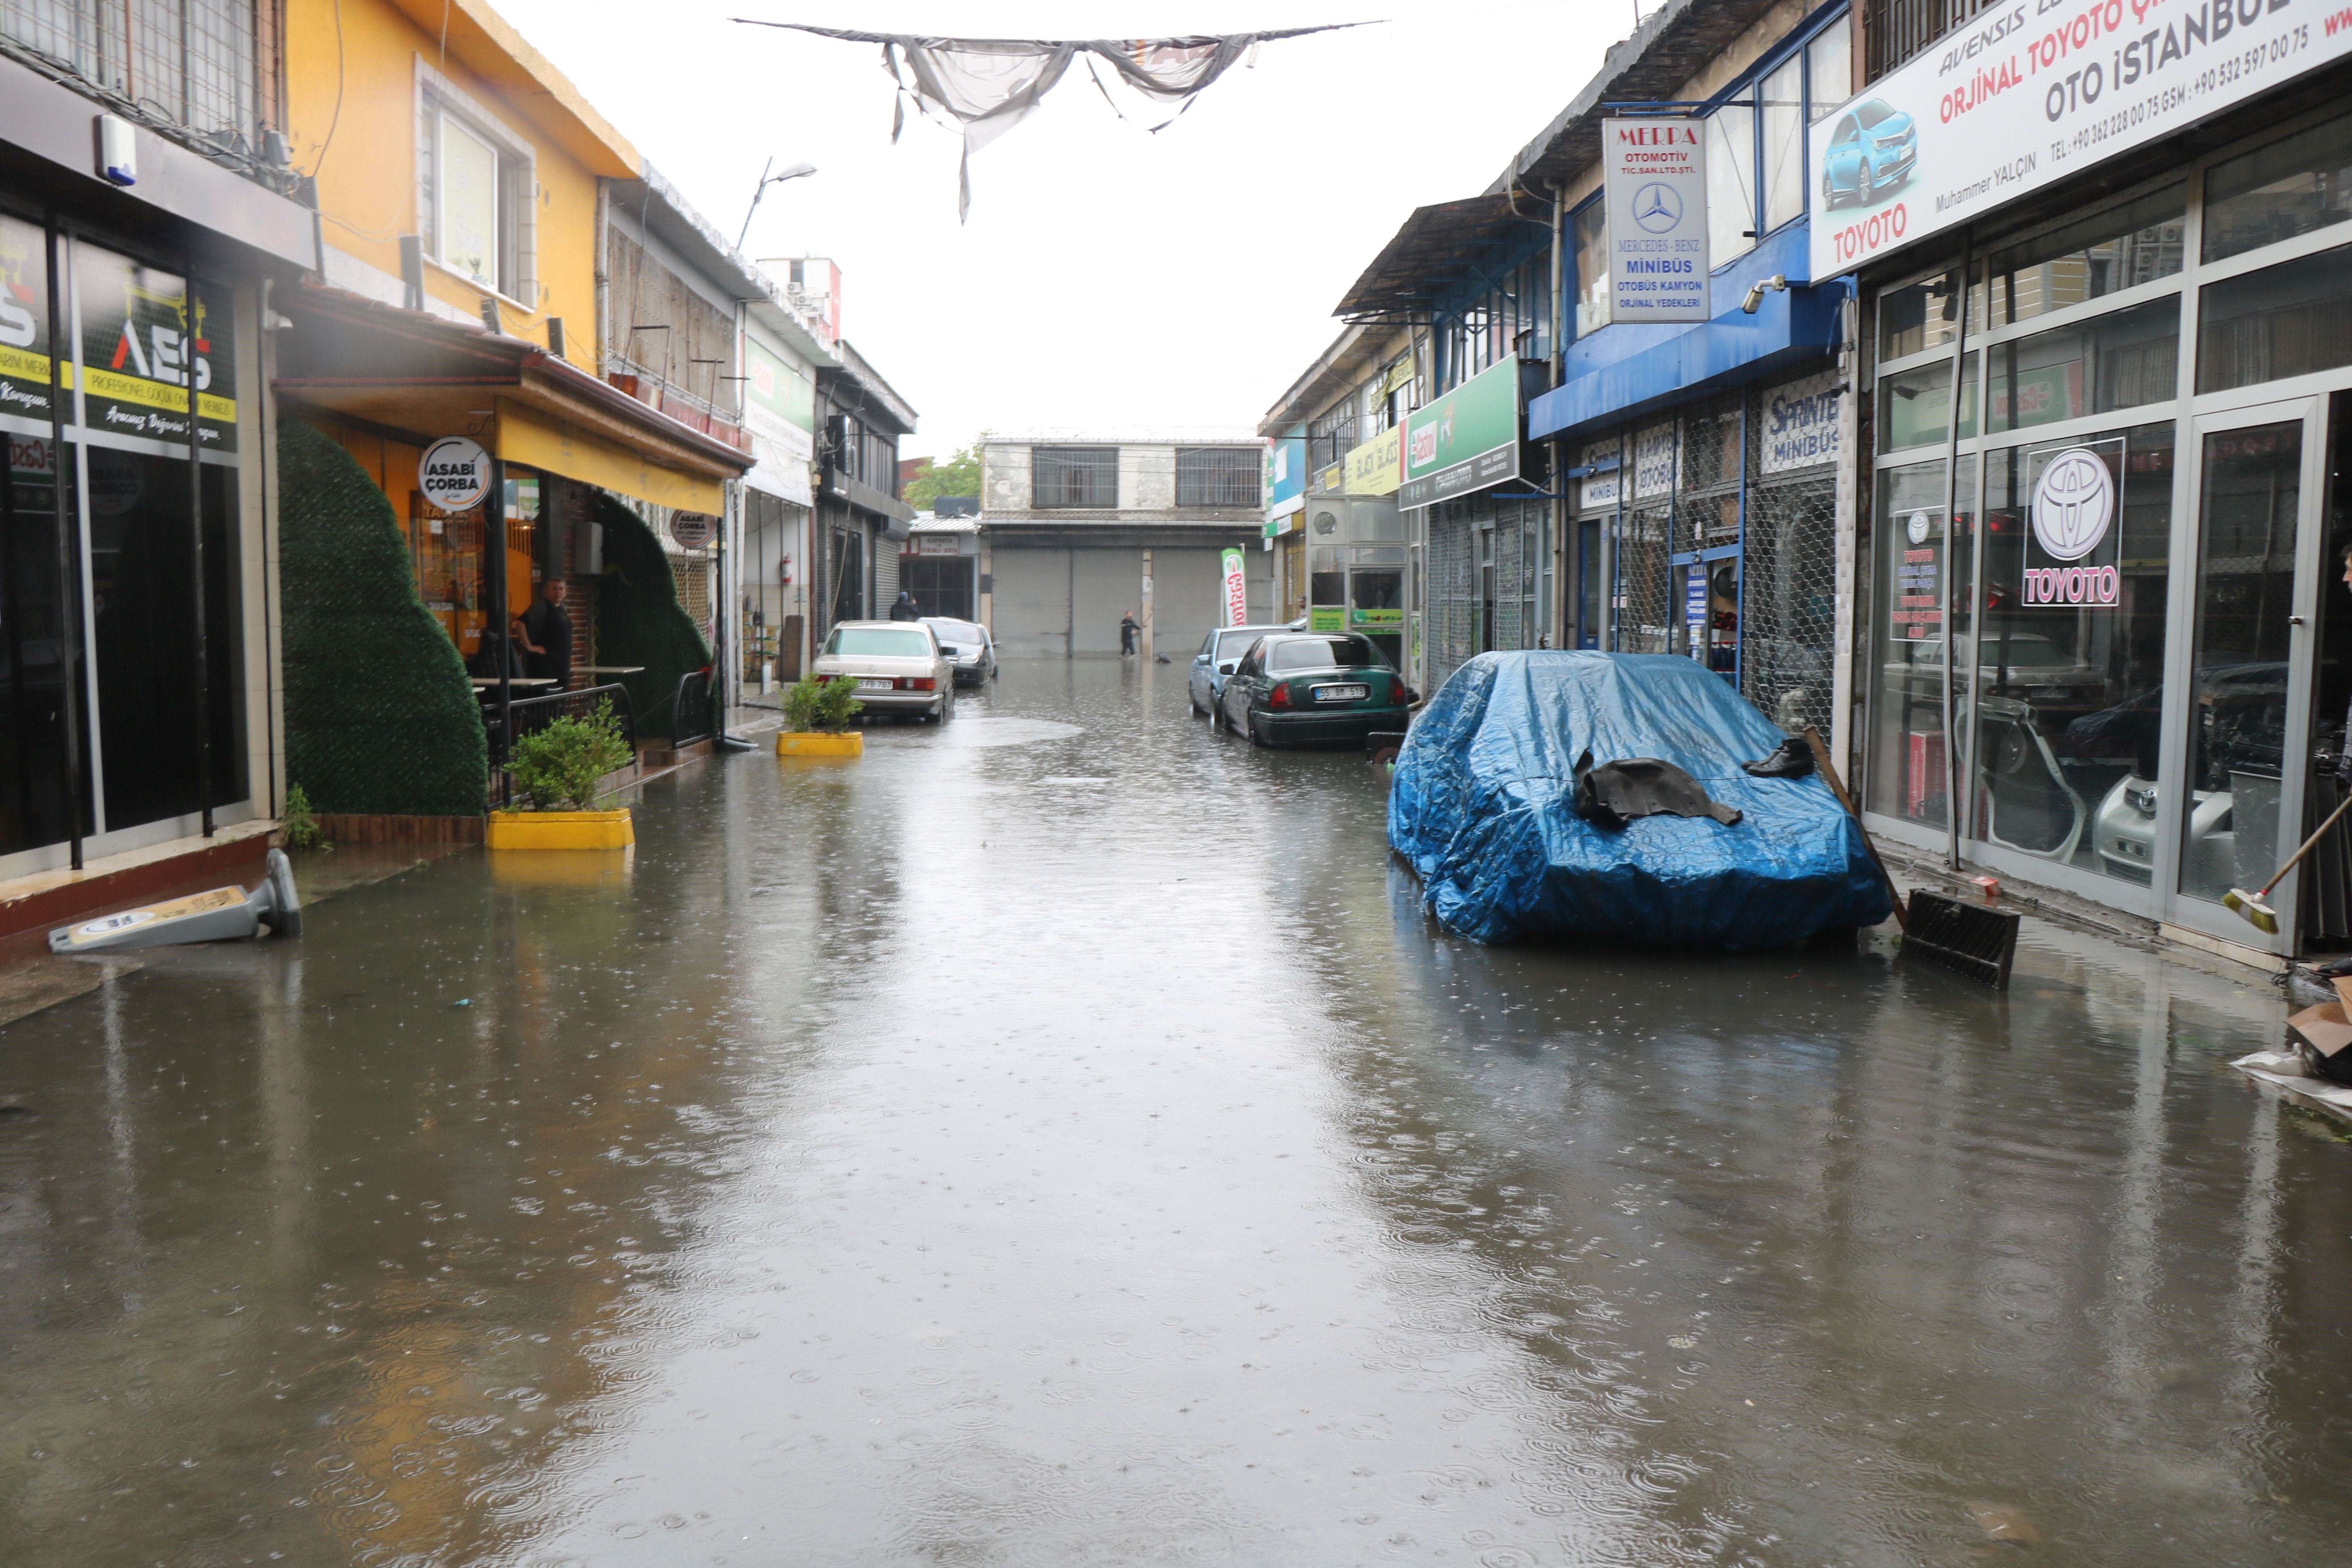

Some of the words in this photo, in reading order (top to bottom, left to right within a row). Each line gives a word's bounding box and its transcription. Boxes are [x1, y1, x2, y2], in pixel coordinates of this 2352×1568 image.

[1939, 4, 2026, 77] AVENSIS
[1941, 56, 2023, 124] ORJİNAL
[2028, 0, 2123, 75] TOYOTO
[2046, 62, 2103, 122] OTO
[2073, 128, 2089, 151] +90
[2092, 119, 2108, 144] 362
[2111, 110, 2128, 136] 228
[2131, 102, 2144, 127] 00
[2147, 95, 2159, 120] 75
[2195, 69, 2216, 95] +90
[2220, 57, 2241, 87] 532
[2245, 44, 2267, 74] 597
[2271, 34, 2288, 63] 00
[2293, 24, 2308, 54] 75
[1617, 127, 1698, 146] MERPA
[1626, 151, 1688, 162] OTOMOTİV
[1936, 177, 1992, 214] Muhammer
[1994, 151, 2036, 187] YALÇIN
[1834, 203, 1907, 263] TOYOTO
[1627, 257, 1693, 273] MİNİBÜS
[1618, 279, 1657, 291] OTOBÜS
[1661, 281, 1702, 291] KAMYON
[1620, 297, 1654, 308] ORJİNAL
[1656, 296, 1700, 307] YEDEKLERİ
[111, 317, 211, 390] AES
[426, 478, 479, 492] ÇORBA
[1904, 549, 1933, 563] TOYOTO
[2025, 565, 2118, 603] TOYOTO
